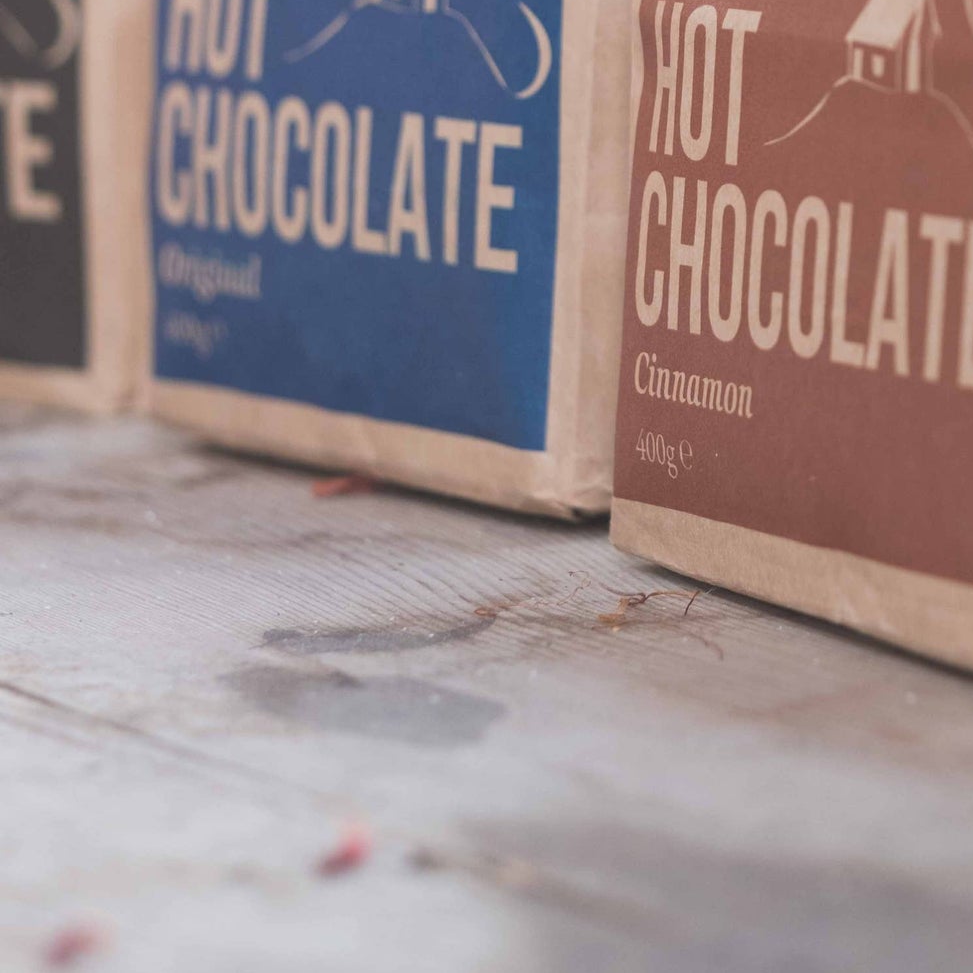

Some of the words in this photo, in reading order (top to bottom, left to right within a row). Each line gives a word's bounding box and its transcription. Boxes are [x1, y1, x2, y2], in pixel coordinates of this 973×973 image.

[648, 0, 764, 166] HOT
[155, 80, 523, 274] CHOCOLATE
[634, 351, 753, 419] Cinnamon
[635, 428, 678, 479] 400g
